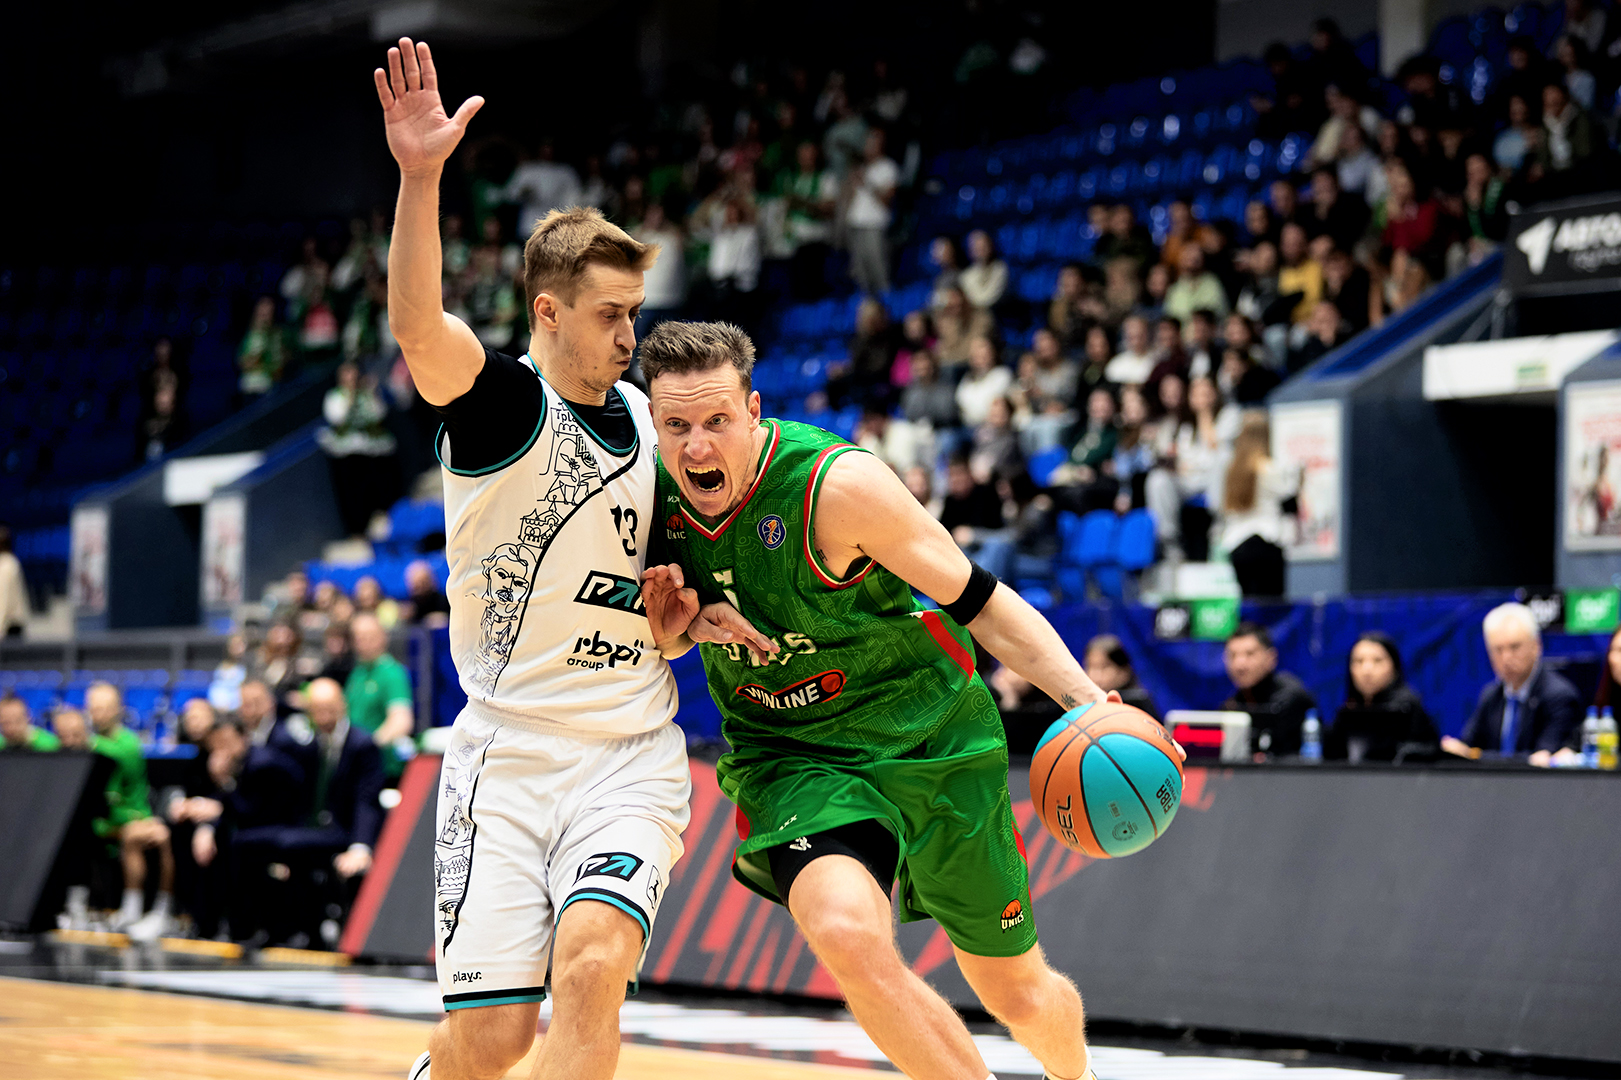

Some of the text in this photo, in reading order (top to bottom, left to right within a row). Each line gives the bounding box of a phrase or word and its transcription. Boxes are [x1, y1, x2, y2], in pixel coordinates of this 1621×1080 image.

[610, 504, 639, 557] 13
[744, 683, 820, 710] WINLINE
[1155, 784, 1174, 815] FIBA
[1000, 911, 1025, 930] UNICS
